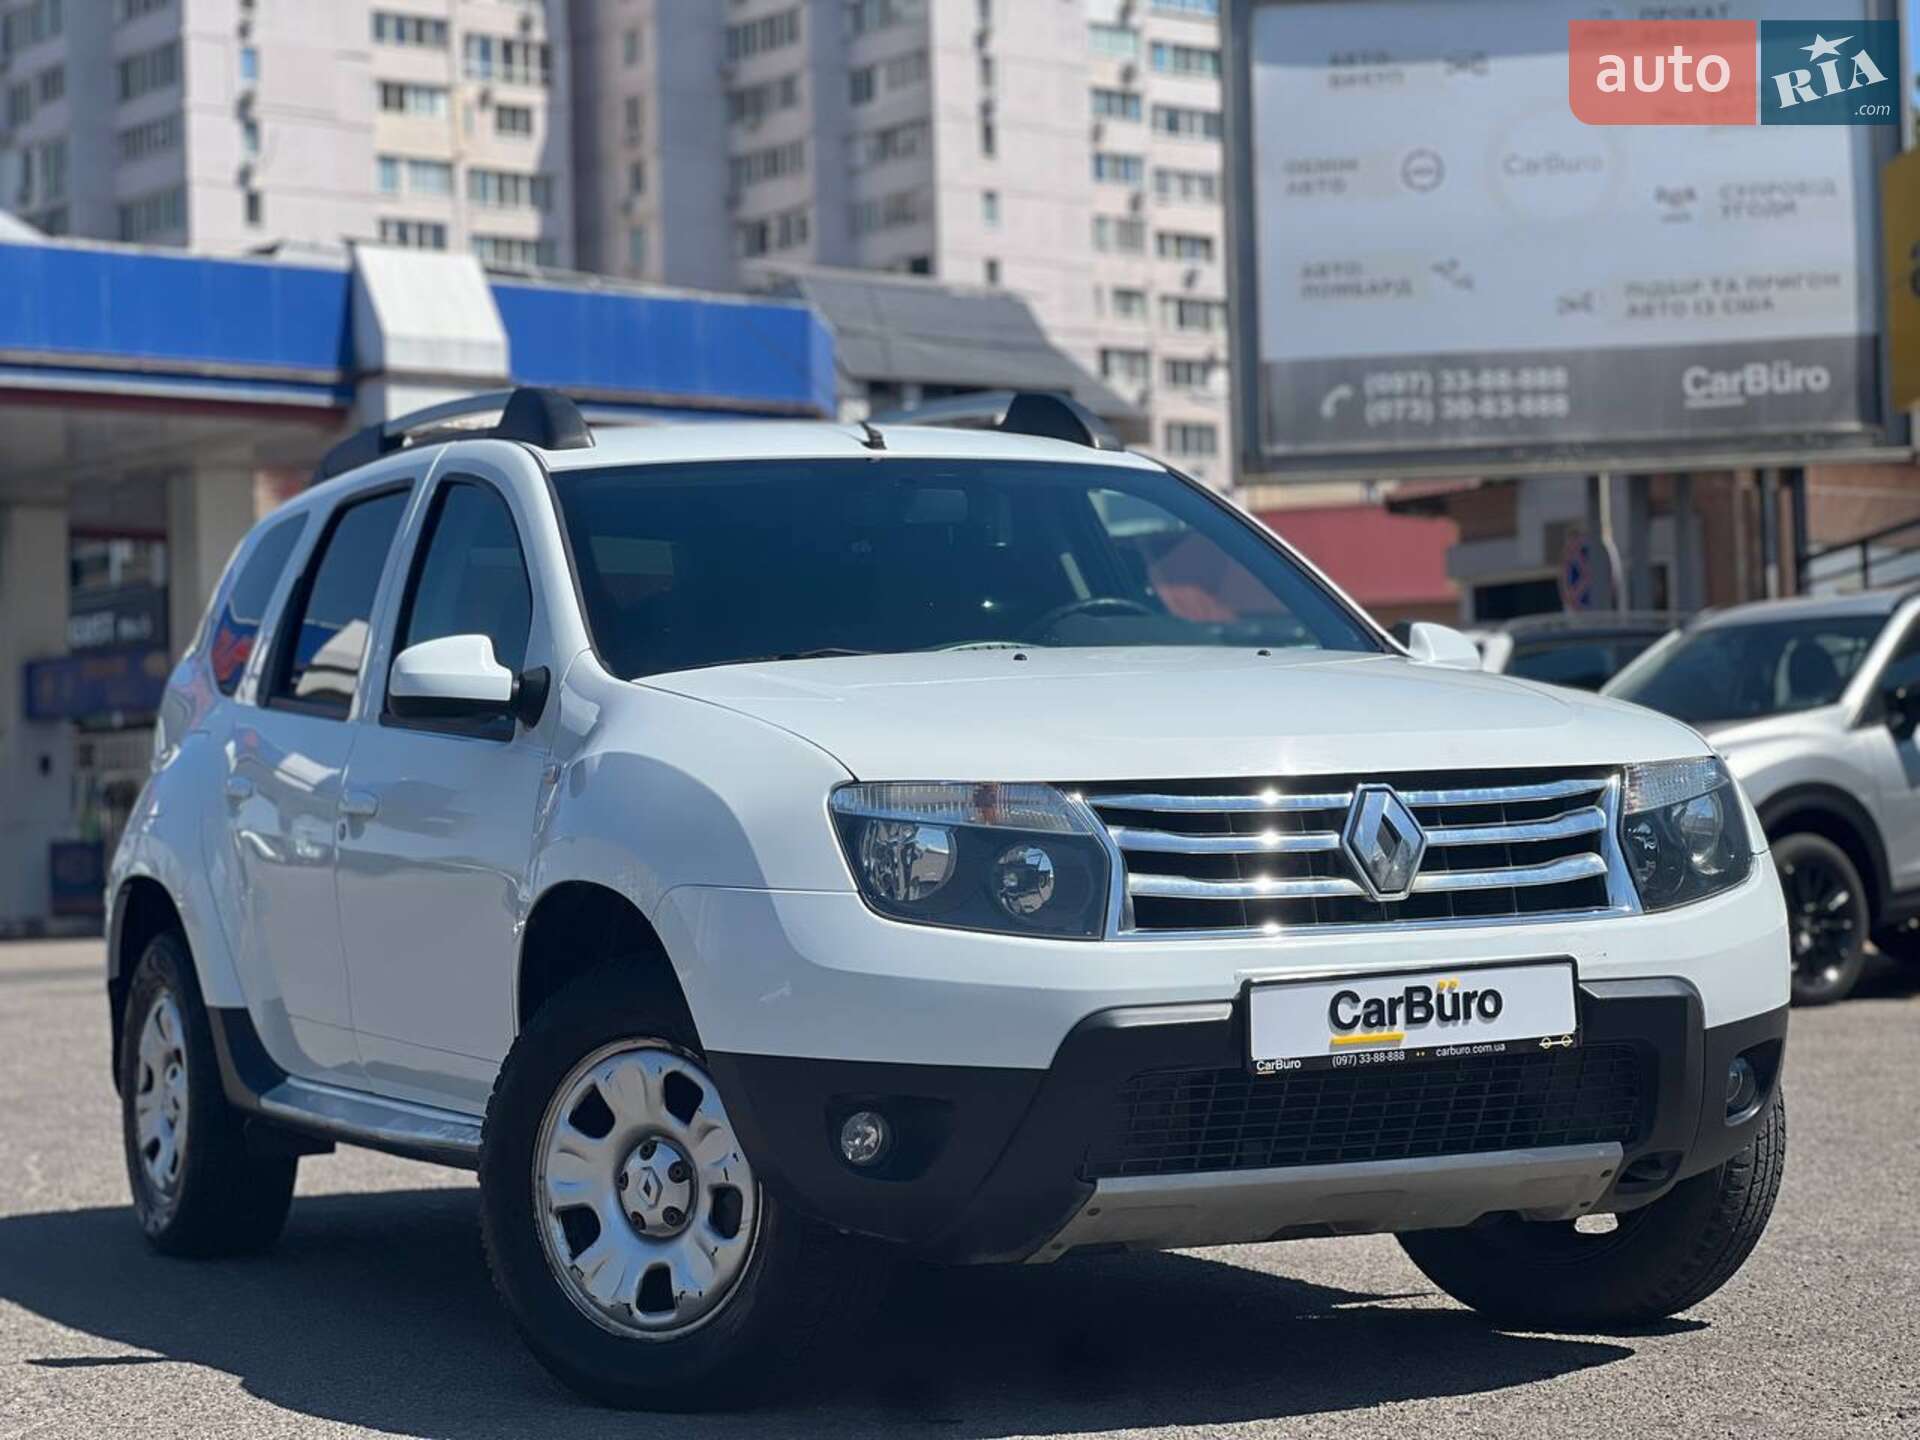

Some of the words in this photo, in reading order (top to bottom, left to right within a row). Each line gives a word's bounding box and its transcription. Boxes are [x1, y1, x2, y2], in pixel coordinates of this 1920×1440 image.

[1682, 360, 1831, 398] CarBüro
[1330, 979, 1503, 1031] CarBüro
[1331, 1054, 1357, 1068] (097)
[1359, 1050, 1405, 1064] 33-88-888
[1435, 1043, 1506, 1057] carburo.com.ua
